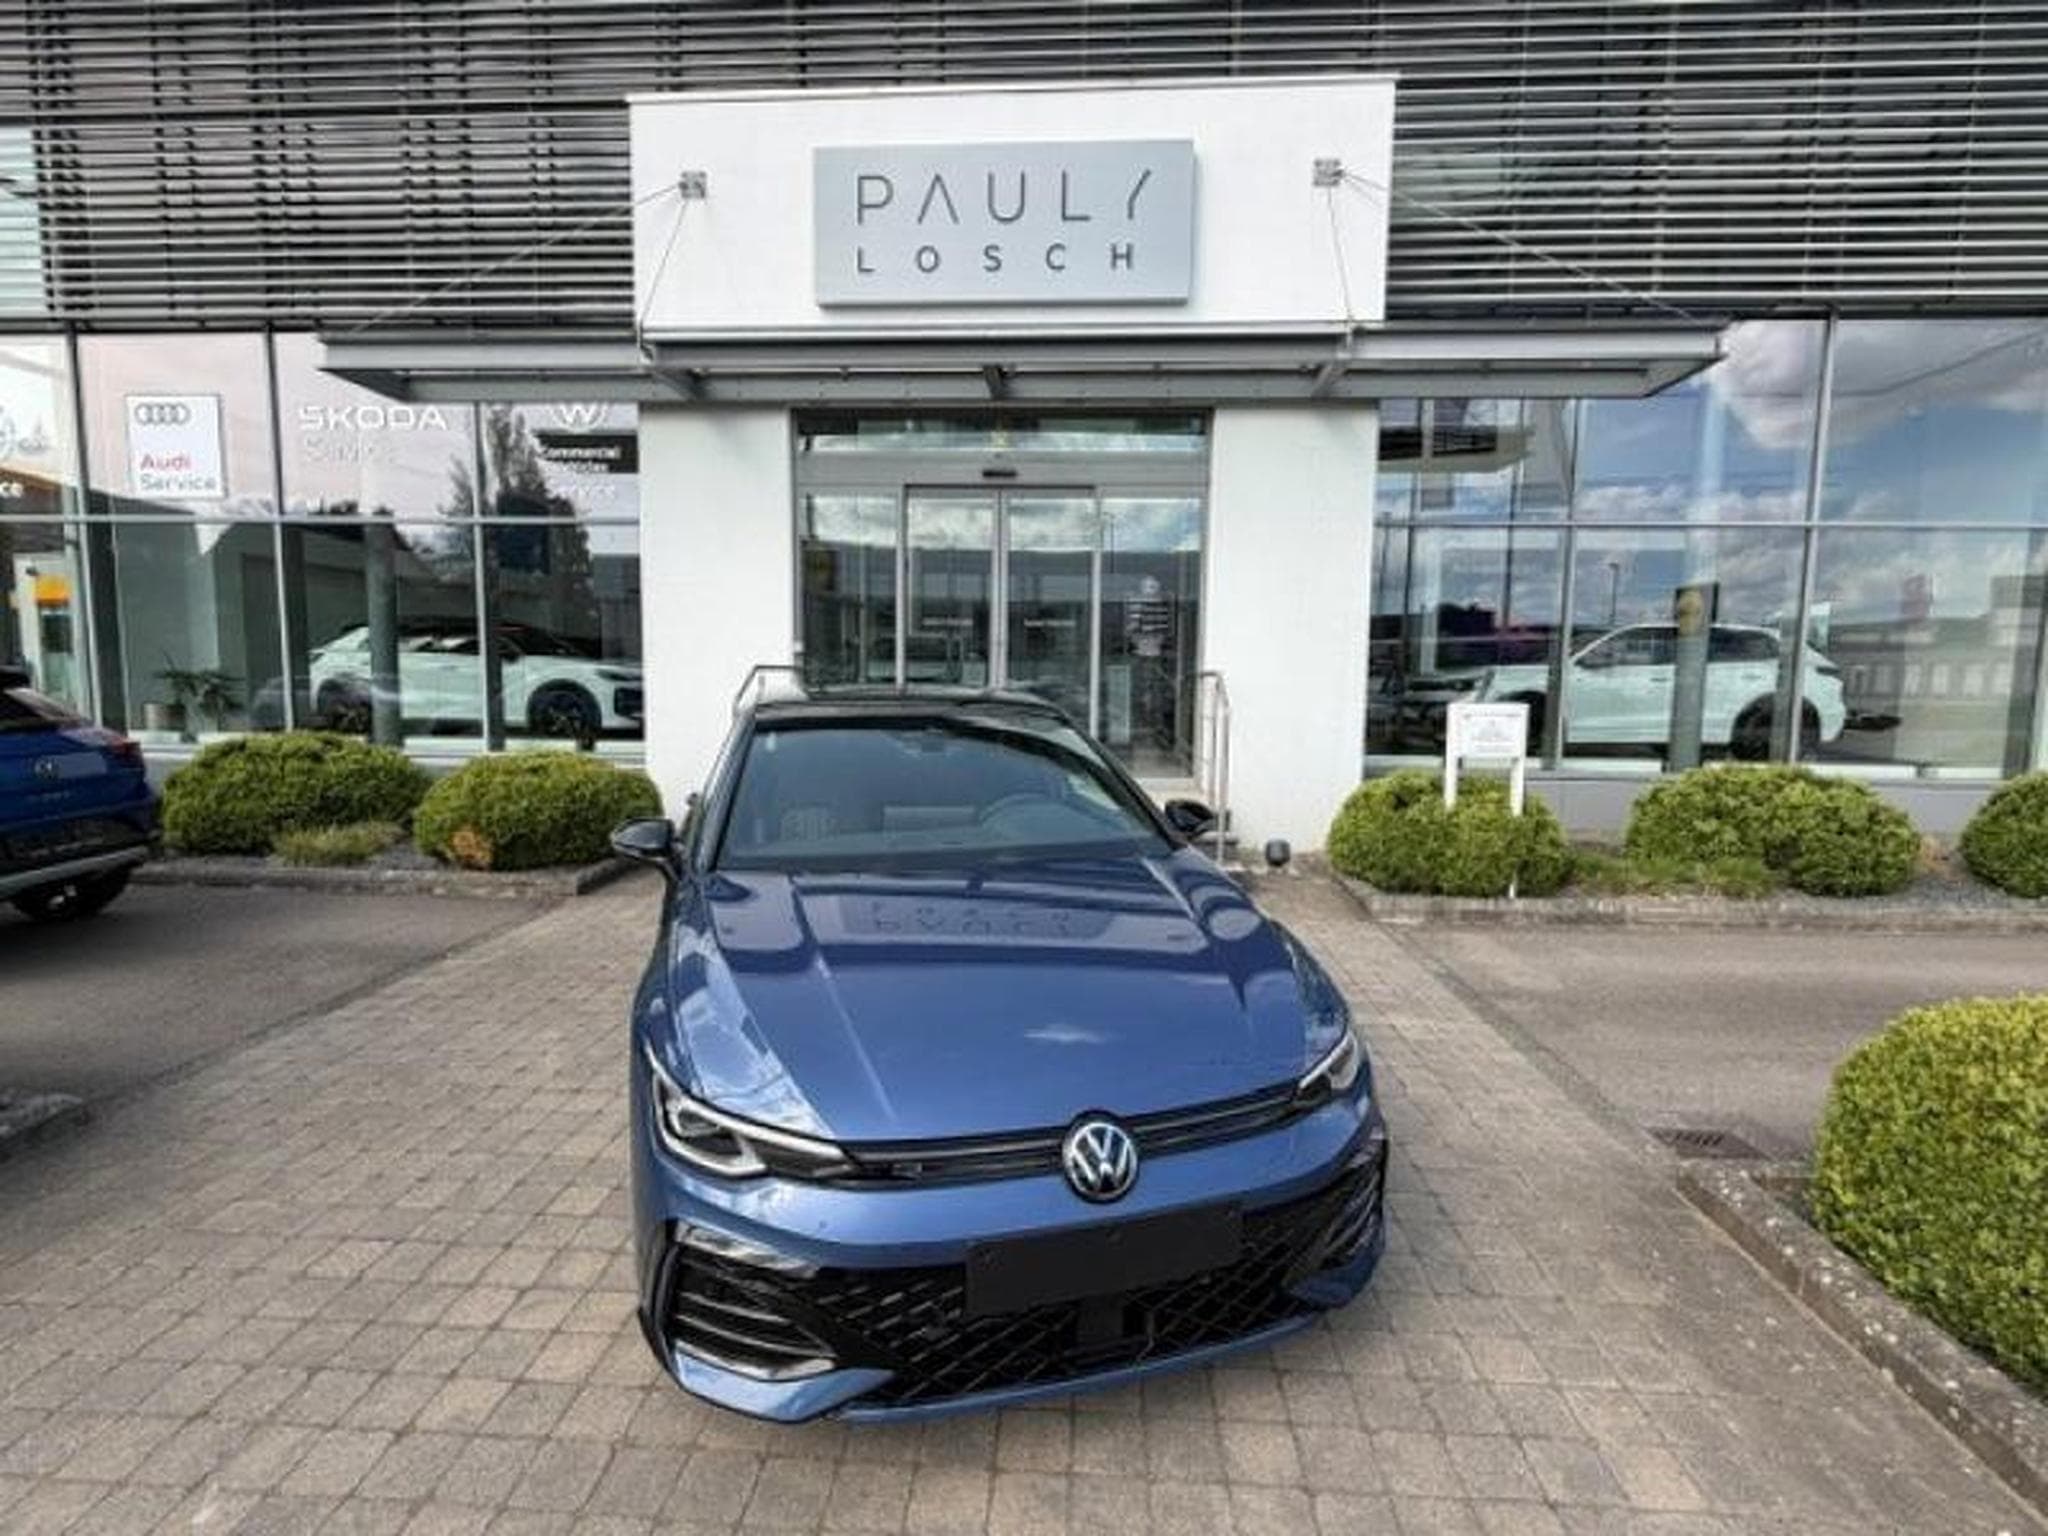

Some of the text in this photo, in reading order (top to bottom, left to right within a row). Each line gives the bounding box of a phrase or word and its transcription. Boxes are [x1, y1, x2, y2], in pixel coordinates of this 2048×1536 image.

[857, 169, 1152, 225] PAULY
[857, 243, 1133, 273] LOSCH
[140, 454, 191, 472] Audi
[139, 475, 216, 491] Service
